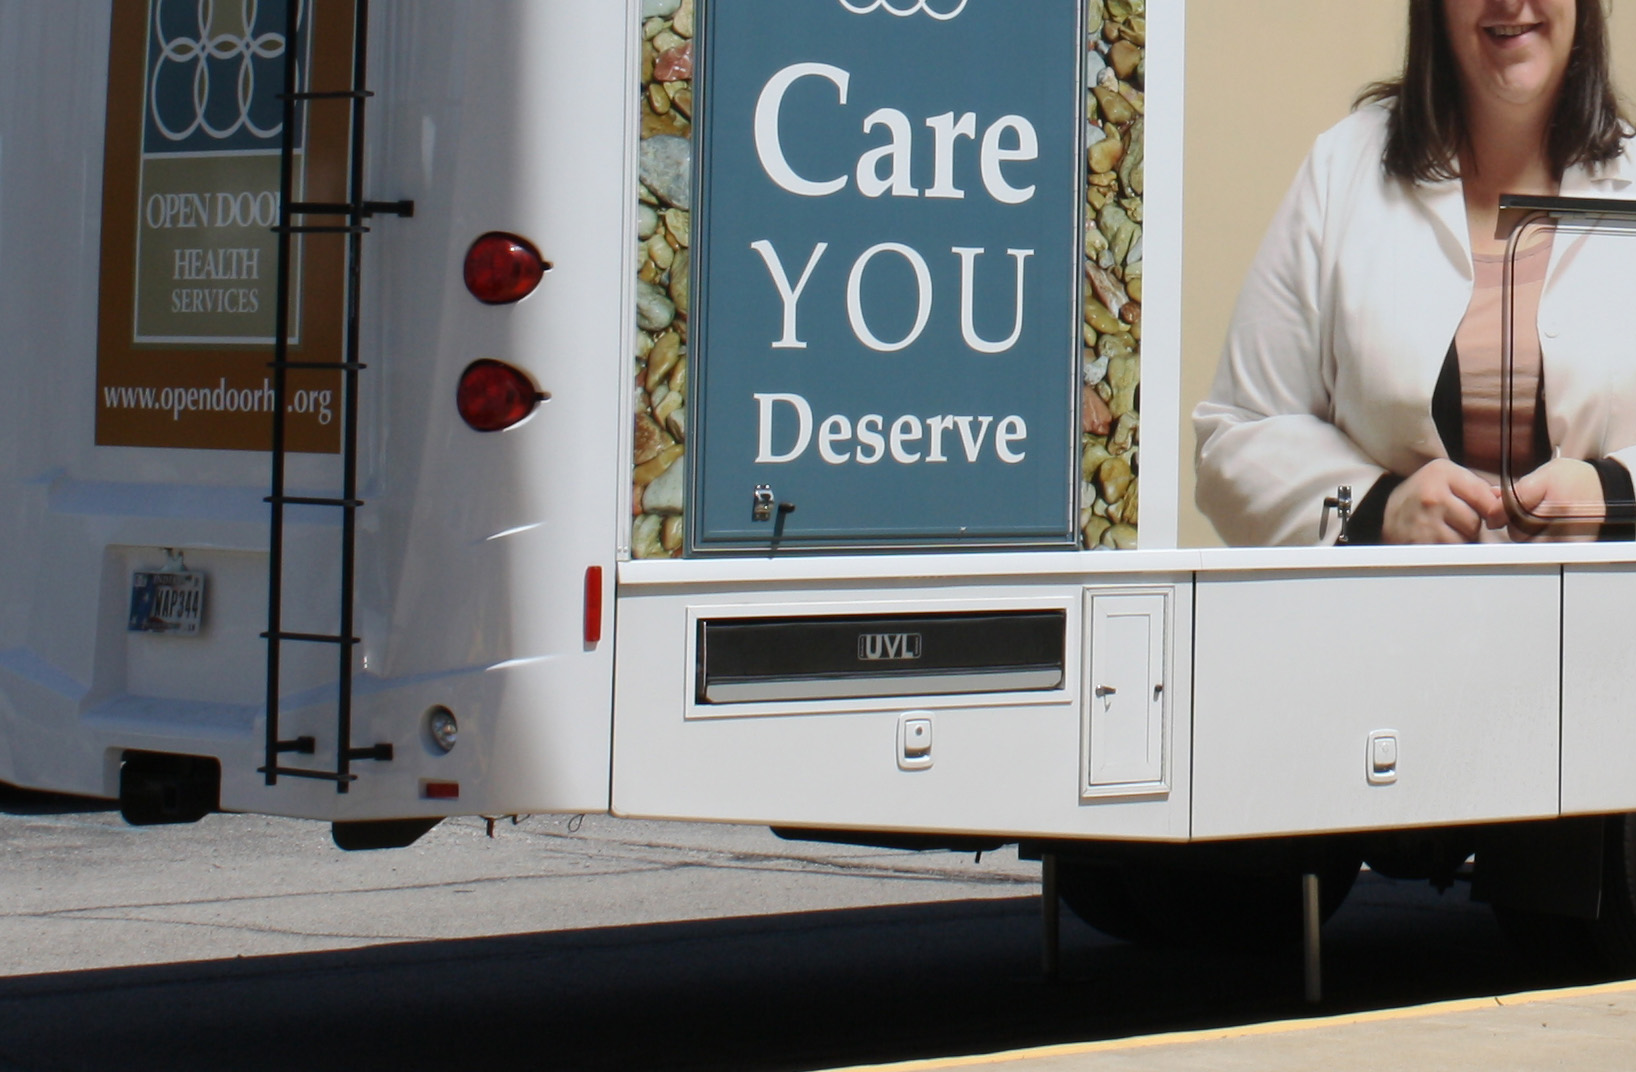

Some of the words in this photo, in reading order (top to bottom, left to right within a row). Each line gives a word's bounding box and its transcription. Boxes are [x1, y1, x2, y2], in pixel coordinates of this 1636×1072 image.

[754, 62, 1038, 204] Care
[146, 192, 212, 229] OPEN
[215, 191, 281, 228] DOO
[172, 249, 260, 280] HEALTH
[171, 288, 260, 313] SERVICES
[750, 240, 1035, 354] YOU
[103, 377, 332, 425] www.opendoorh.org
[753, 392, 1028, 464] Deserve
[866, 633, 913, 659] UVL
